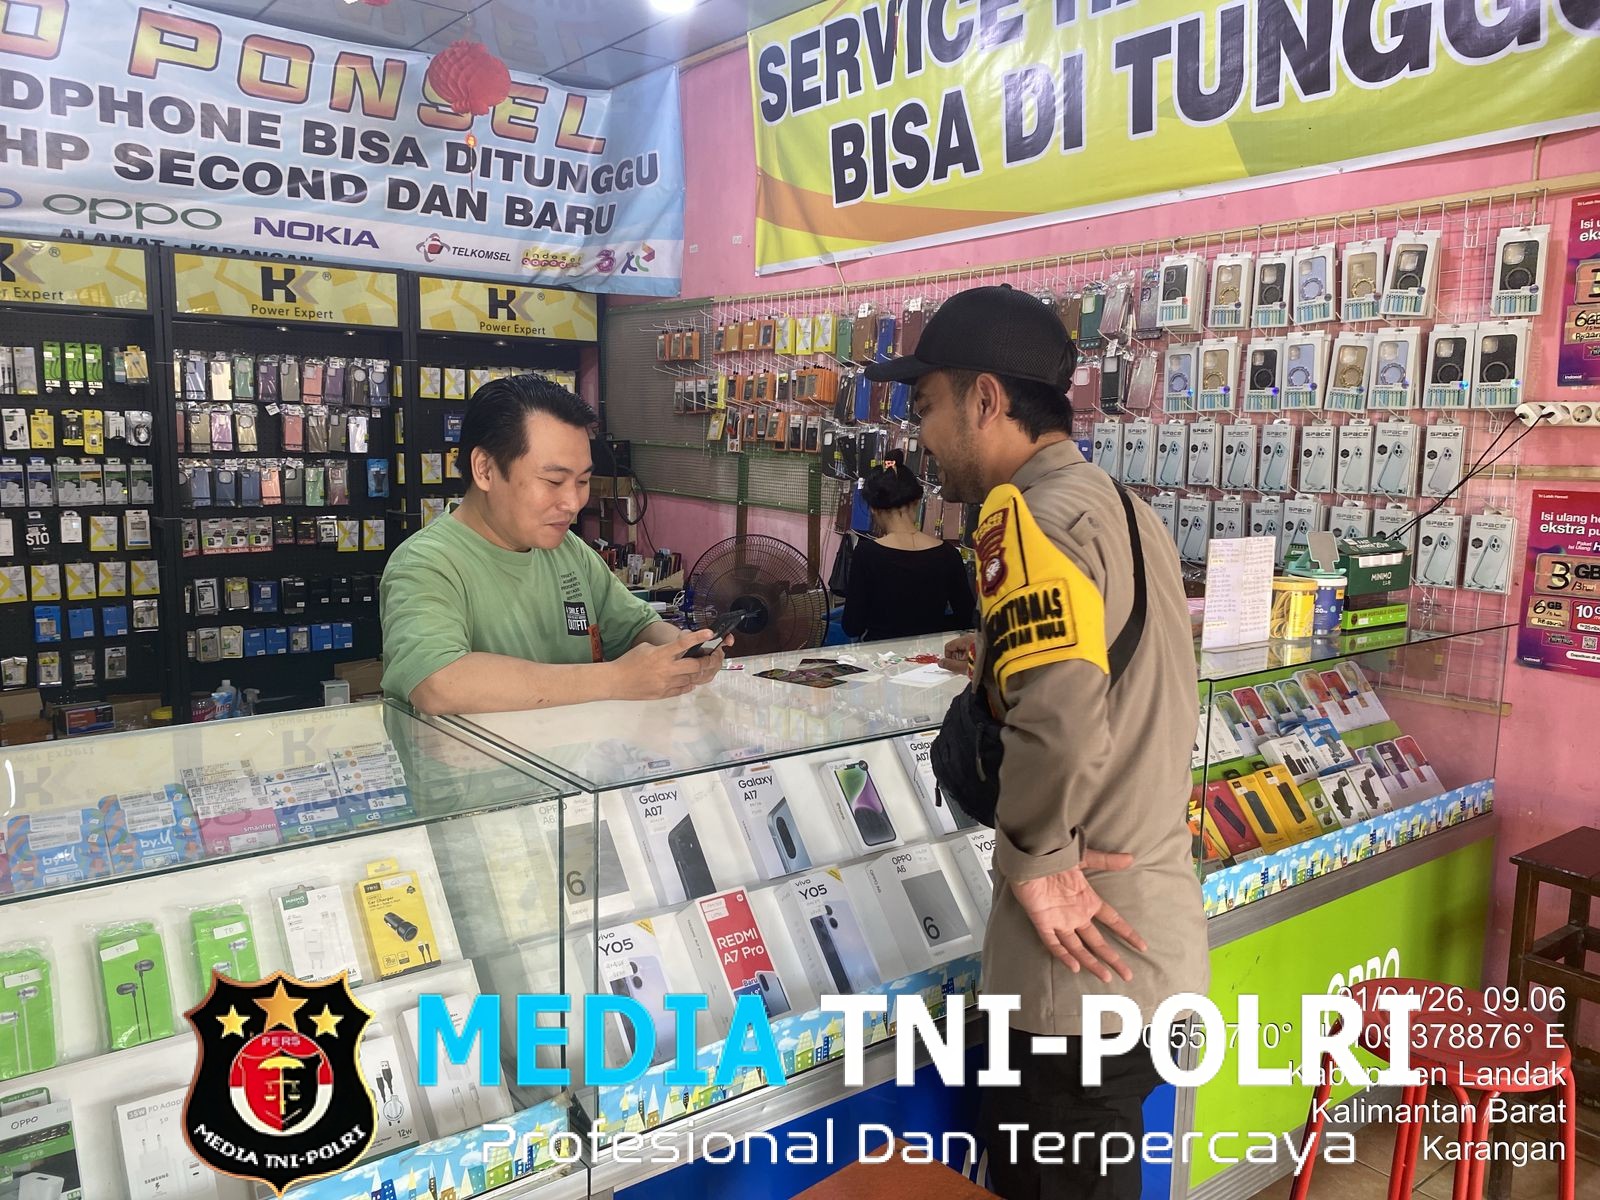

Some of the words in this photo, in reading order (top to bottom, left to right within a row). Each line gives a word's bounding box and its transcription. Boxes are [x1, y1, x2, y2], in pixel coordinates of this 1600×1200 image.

[759, 0, 1025, 124] SERVICE
[830, 88, 981, 205] BISA
[1003, 53, 1084, 165] DI
[1113, 0, 1600, 136] TUNGG
[303, 120, 429, 169] BISA
[445, 141, 659, 195] DITUNGGU
[113, 142, 368, 204] SECOND
[387, 177, 488, 223] DAN
[504, 195, 617, 237] BARU
[253, 216, 380, 250] NOKIA
[451, 246, 512, 263] TELKOMSEL
[13, 286, 64, 302] Expert
[250, 303, 291, 318] Power
[293, 306, 334, 320] Expert
[479, 321, 511, 334] Power
[513, 323, 546, 336] Expert
[1541, 511, 1554, 522] Isi
[1556, 512, 1587, 525] ulang
[1539, 522, 1585, 536] ekstra
[1370, 571, 1393, 582] MINIMO
[1575, 604, 1594, 619] 10
[567, 619, 588, 631] OUTFIT
[915, 752, 930, 763] A07
[737, 775, 774, 789] Galaxy
[638, 790, 679, 806] Galaxy
[743, 789, 758, 802] A17
[366, 811, 382, 821] GB
[643, 805, 663, 819] A07
[298, 824, 314, 834] GB
[970, 834, 985, 842] vivo
[975, 839, 997, 853] Y05
[891, 853, 912, 866] OPPO
[896, 865, 907, 874] A6
[566, 870, 587, 897] 6
[794, 878, 811, 888] vivo
[798, 883, 828, 901] Y05
[378, 895, 394, 905] Charger
[922, 916, 941, 940] 6
[598, 931, 615, 943] vivo
[716, 927, 759, 951] REDMI
[600, 937, 635, 957] Y05
[722, 951, 739, 966] A7
[741, 944, 765, 960] Pro
[742, 977, 758, 987] Baru
[127, 1107, 147, 1120] 35W
[10, 1115, 39, 1131] OPPO
[397, 1127, 413, 1137] 12W
[144, 1172, 170, 1185] SAMSUNG
